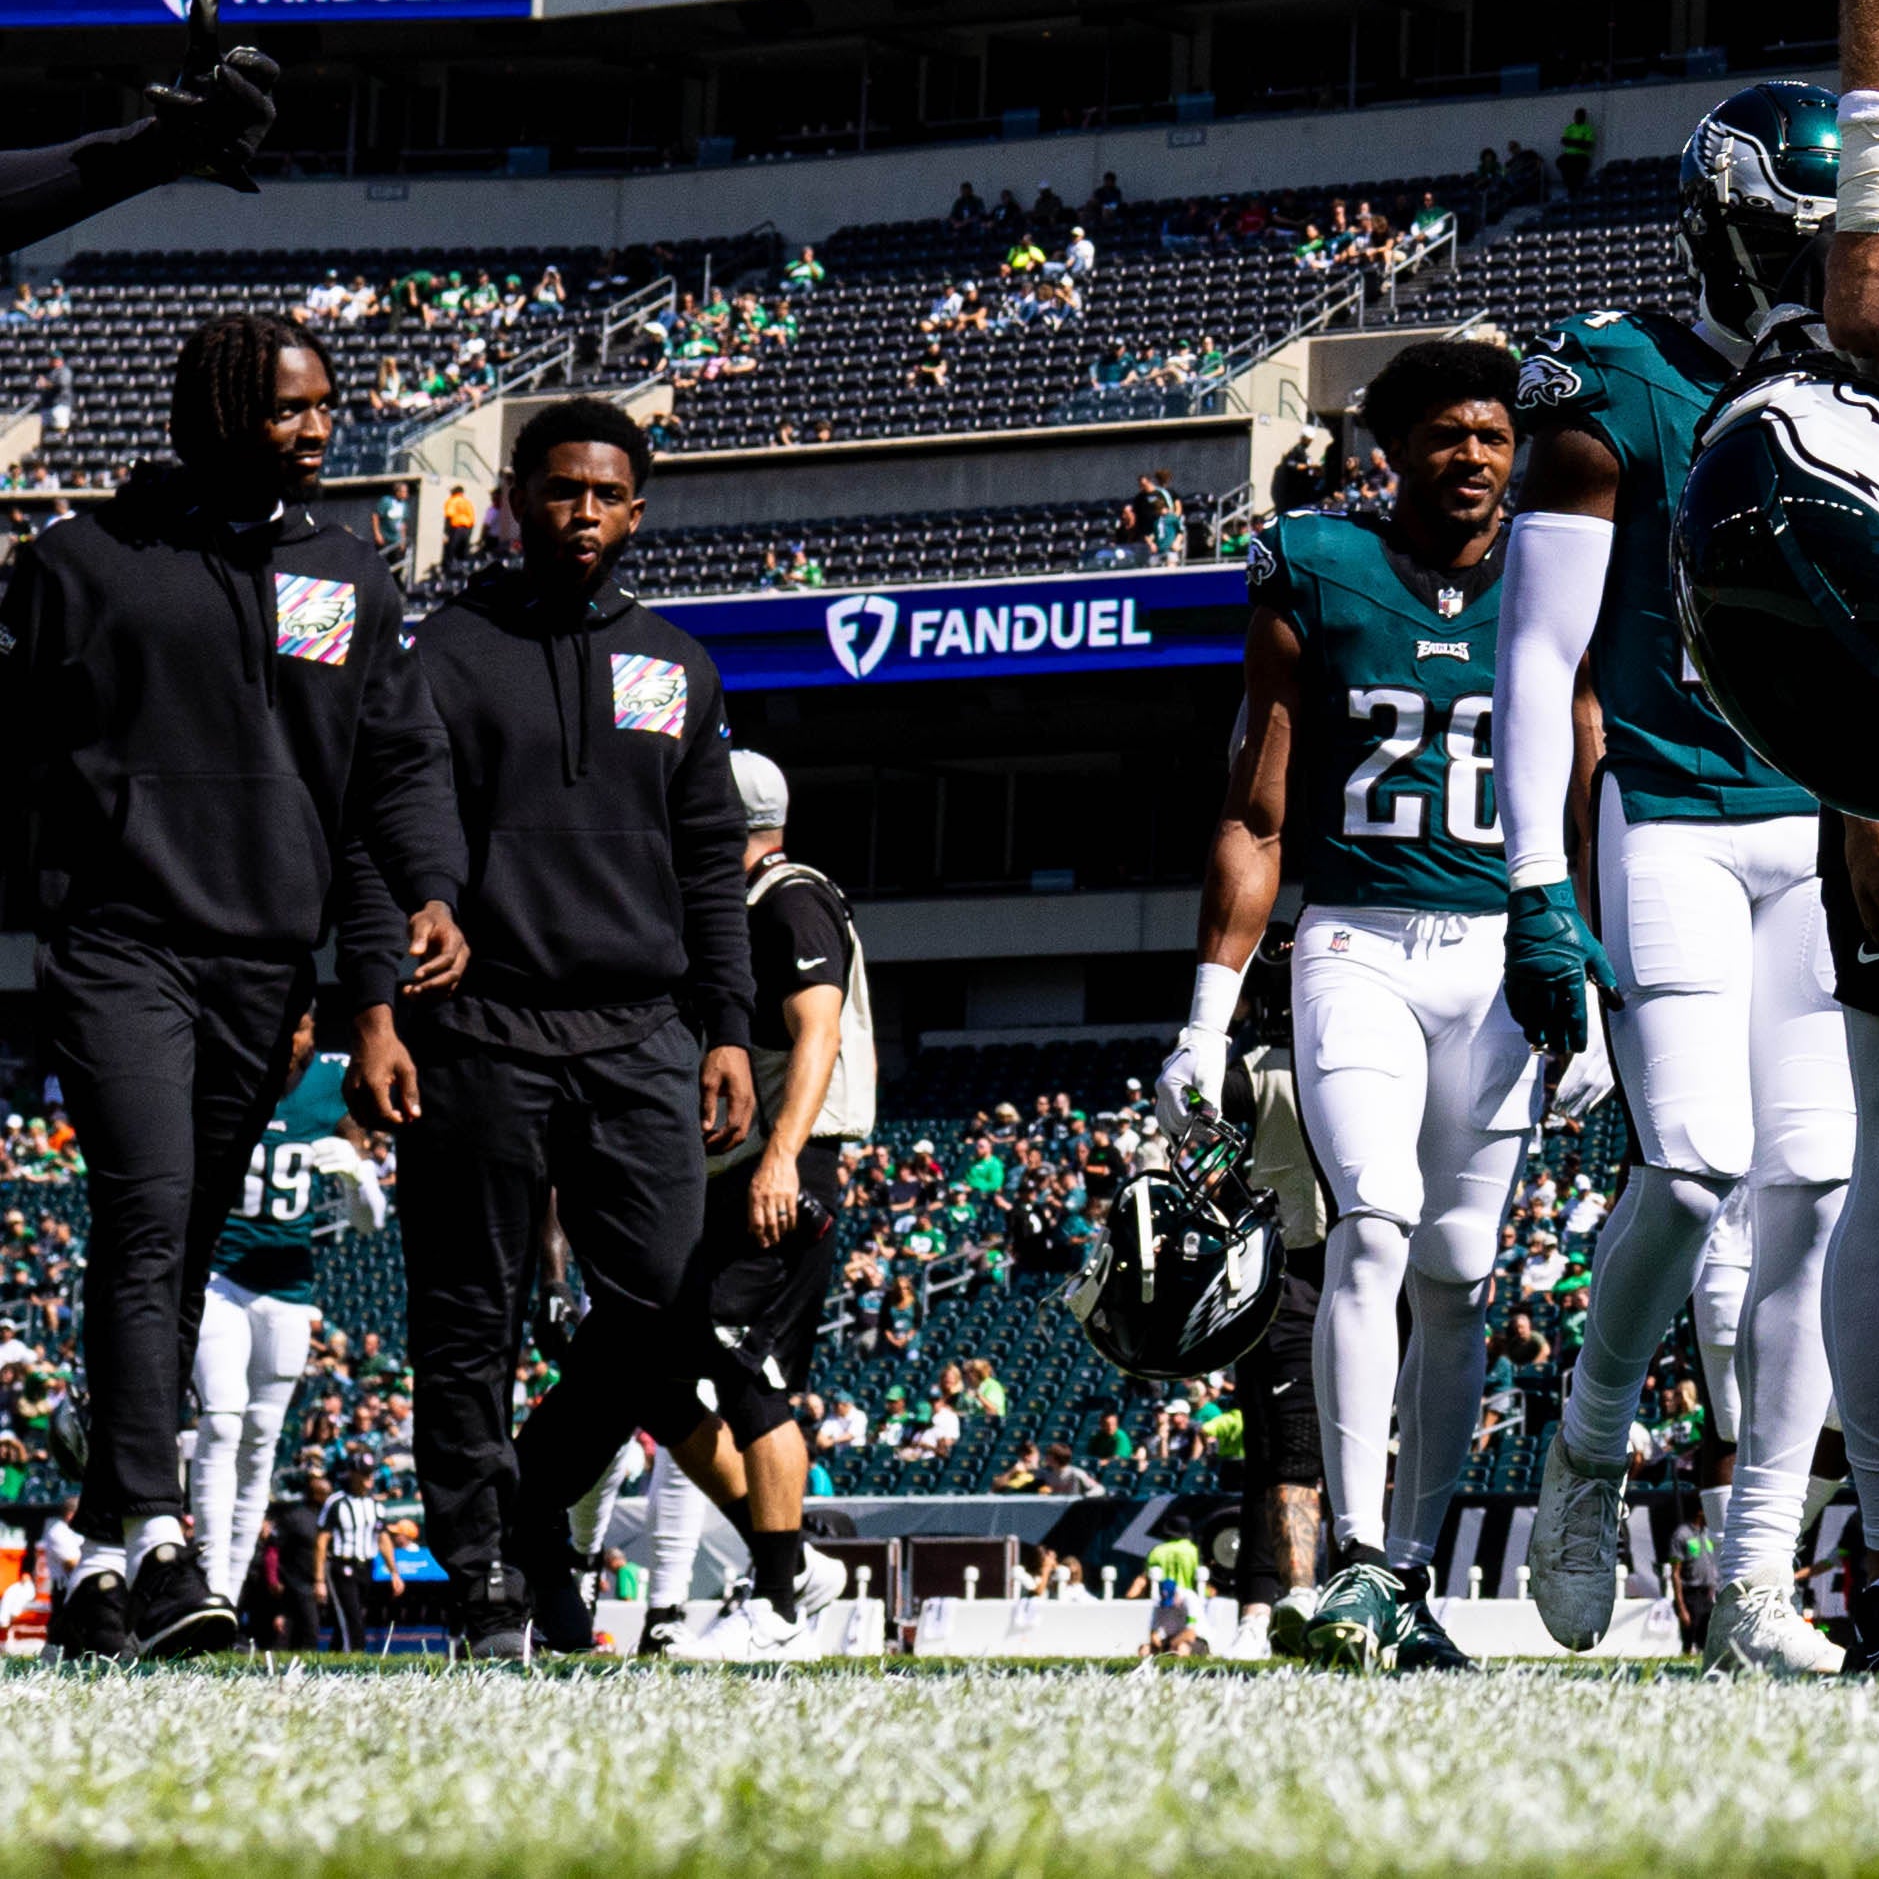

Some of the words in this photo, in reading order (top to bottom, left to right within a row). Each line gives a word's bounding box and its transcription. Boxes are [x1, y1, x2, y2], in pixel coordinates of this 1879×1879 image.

[909, 598, 1151, 657] FANDUEL
[1415, 639, 1471, 661] EAGLES
[1340, 686, 1507, 846] 28
